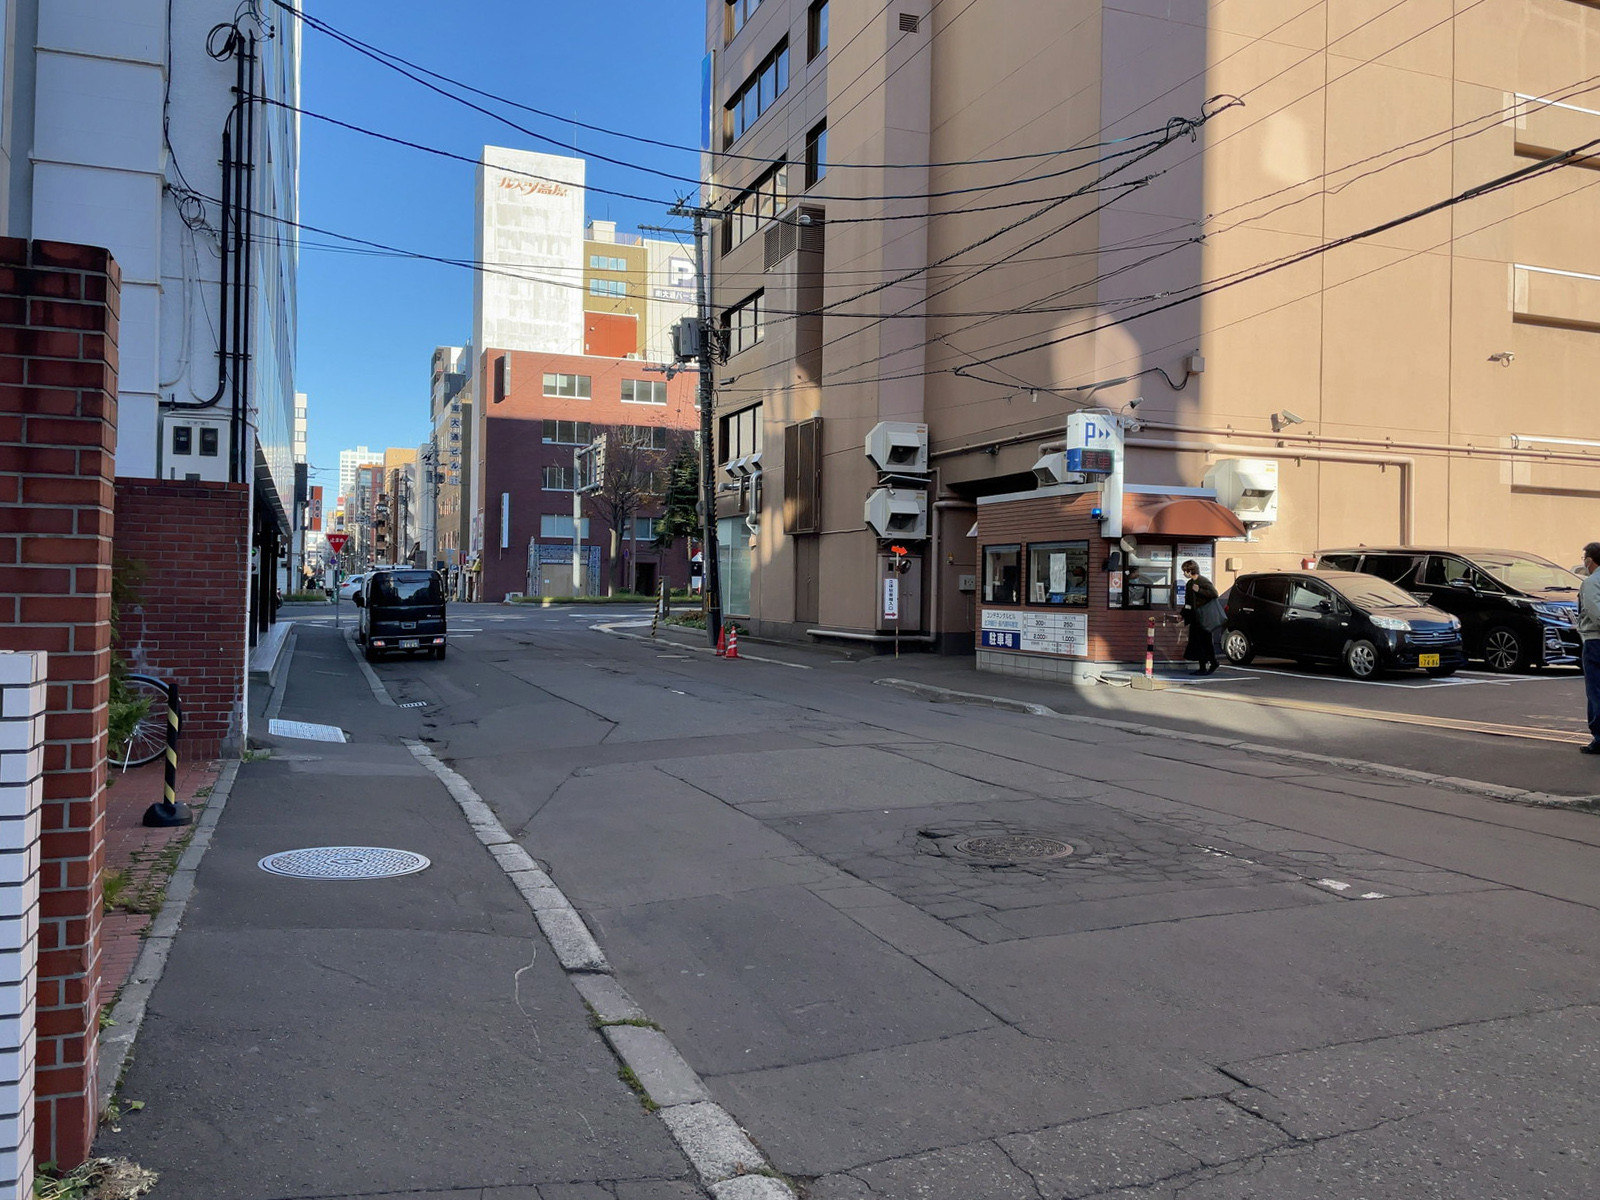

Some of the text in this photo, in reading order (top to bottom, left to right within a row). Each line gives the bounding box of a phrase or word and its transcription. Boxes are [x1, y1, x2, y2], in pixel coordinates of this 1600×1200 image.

[499, 177, 568, 197] ルスツ高原
[671, 259, 697, 285] P
[1085, 422, 1096, 447] P
[989, 632, 1013, 647] 駐車場
